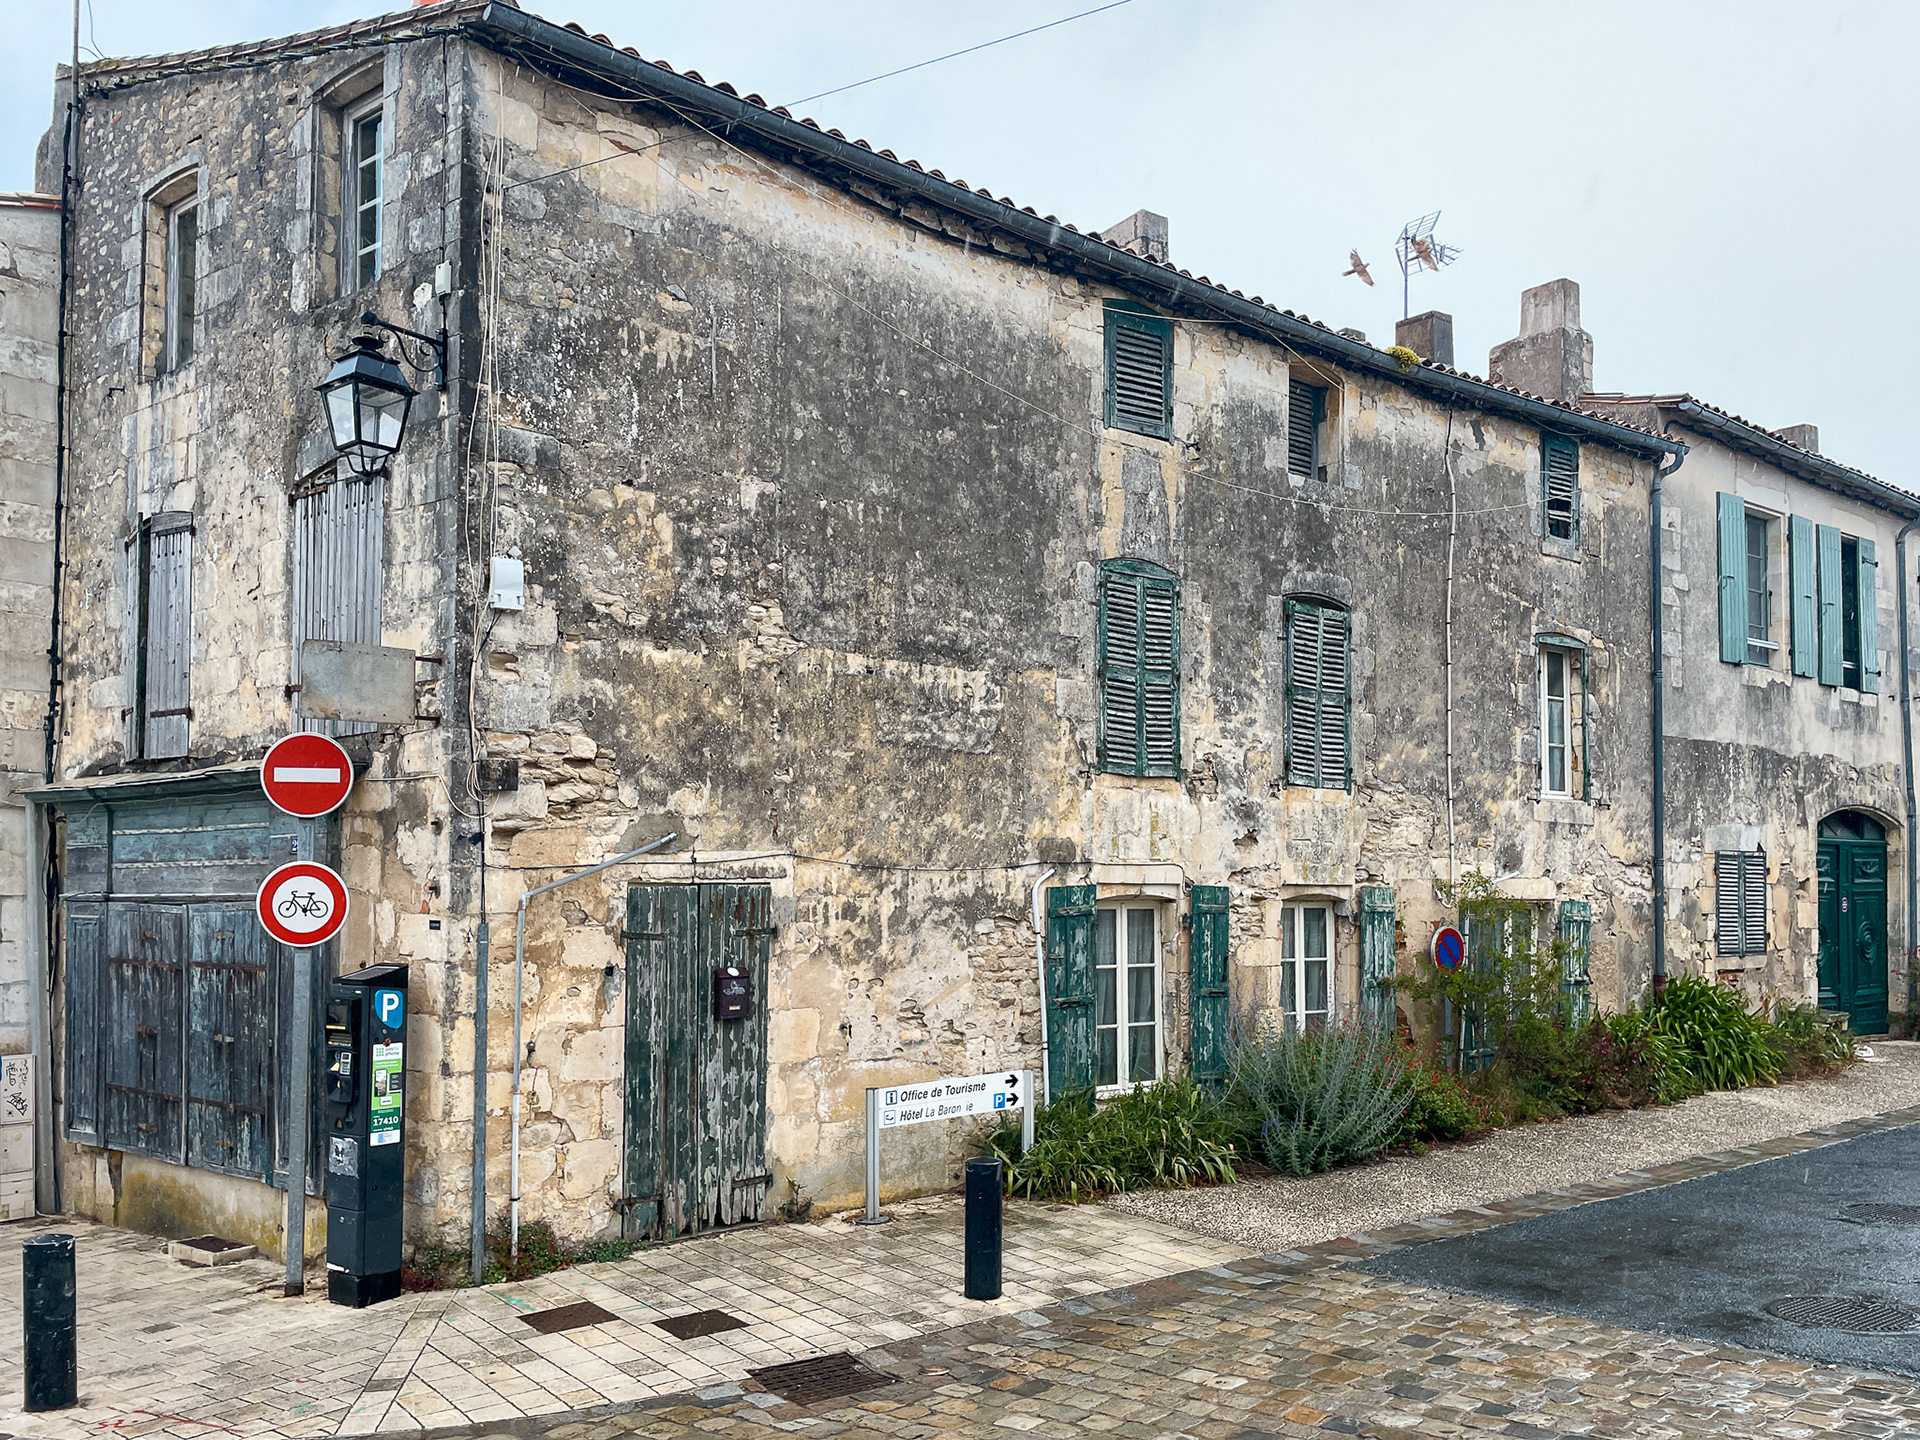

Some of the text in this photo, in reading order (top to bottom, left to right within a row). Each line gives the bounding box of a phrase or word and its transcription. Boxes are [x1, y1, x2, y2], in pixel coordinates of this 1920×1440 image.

[382, 993, 400, 1022] P
[900, 1089, 928, 1102] Office
[931, 1087, 943, 1098] de
[945, 1082, 986, 1096] Tourisme
[995, 1094, 1004, 1108] P
[373, 1116, 399, 1127] 17410
[900, 1108, 923, 1122] Hôtel
[925, 1107, 936, 1118] La
